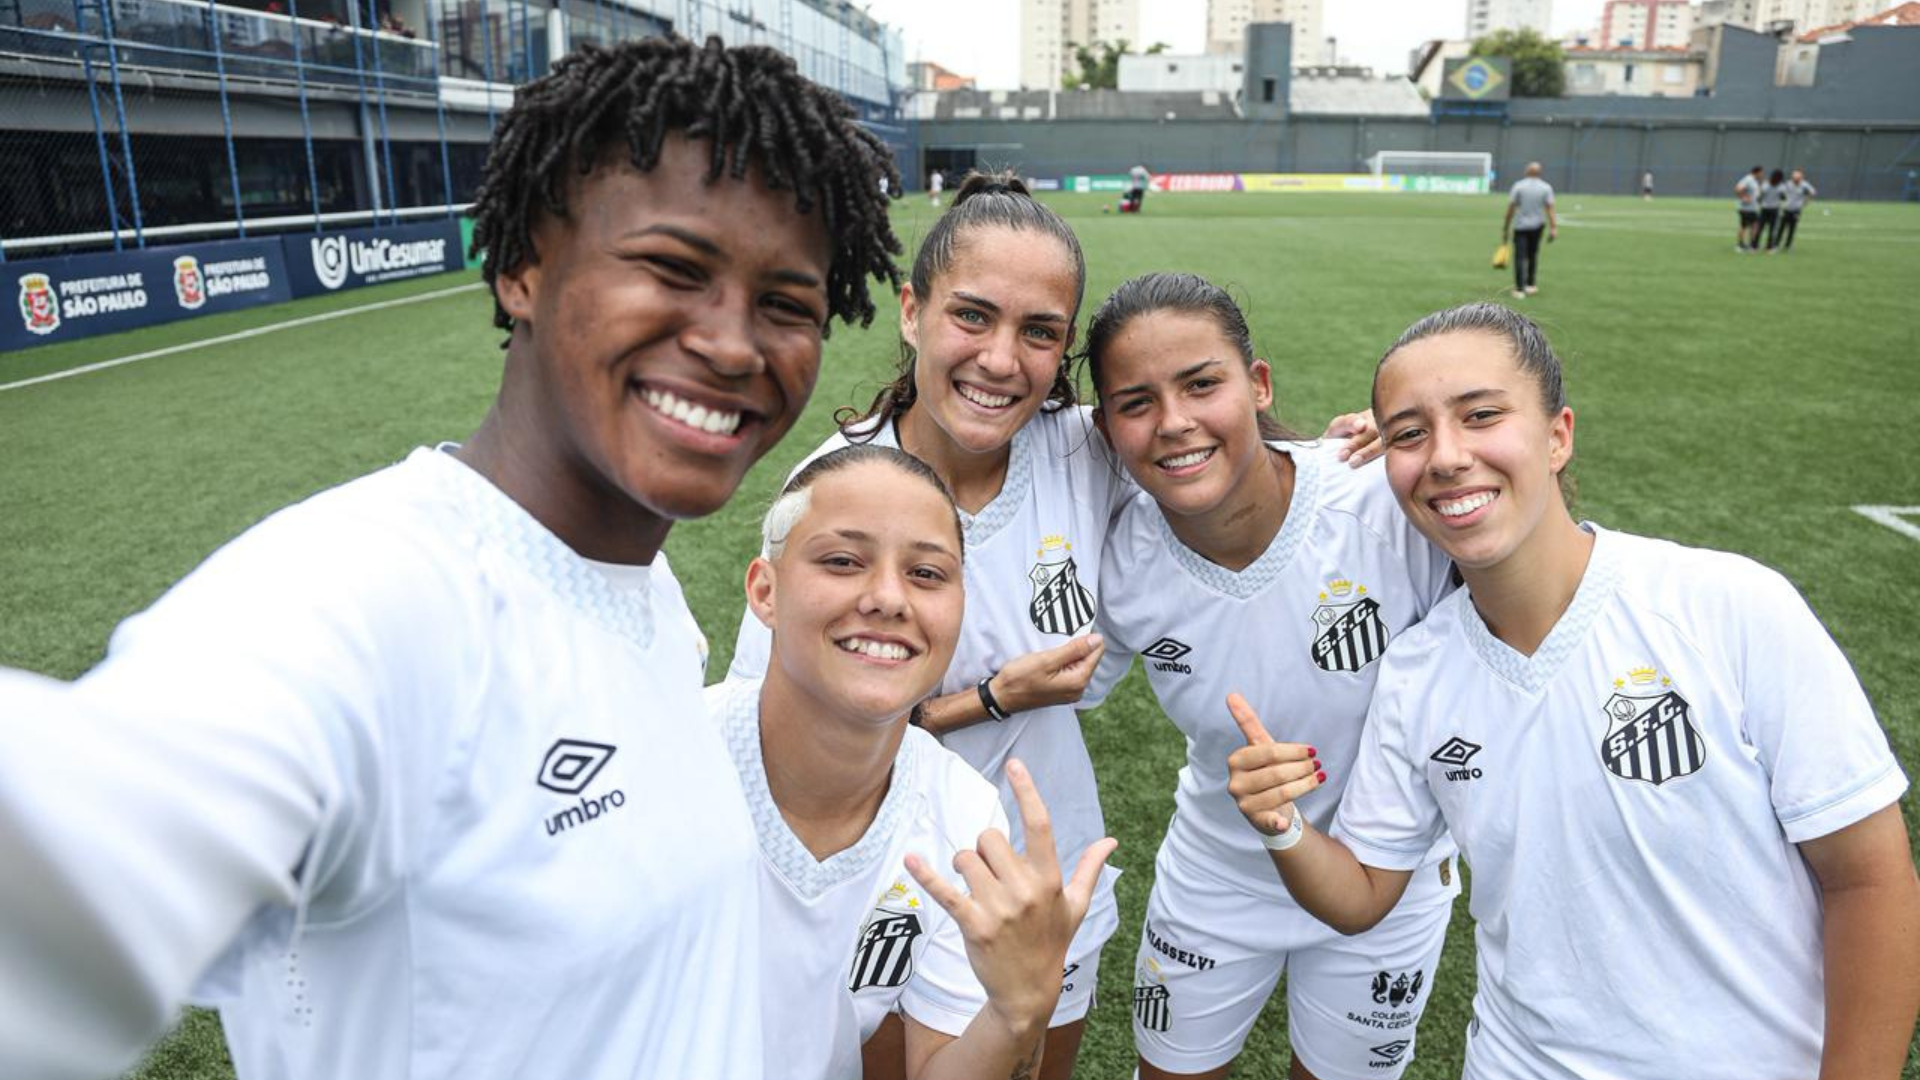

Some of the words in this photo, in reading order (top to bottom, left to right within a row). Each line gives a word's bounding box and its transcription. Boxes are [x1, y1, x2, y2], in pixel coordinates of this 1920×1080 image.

[350, 238, 446, 274] UniCesumar
[59, 275, 127, 297] PREFEITURA
[126, 272, 143, 289] DE
[206, 274, 232, 297] SÃO
[231, 272, 270, 292] PAULO
[62, 292, 98, 319] SÃO
[97, 289, 148, 314] PAULO
[1153, 660, 1192, 675] umbro
[1610, 697, 1682, 757] S.F.C.
[1445, 767, 1483, 782] umbro
[545, 789, 625, 836] umbro
[1347, 1012, 1384, 1029] SANTA
